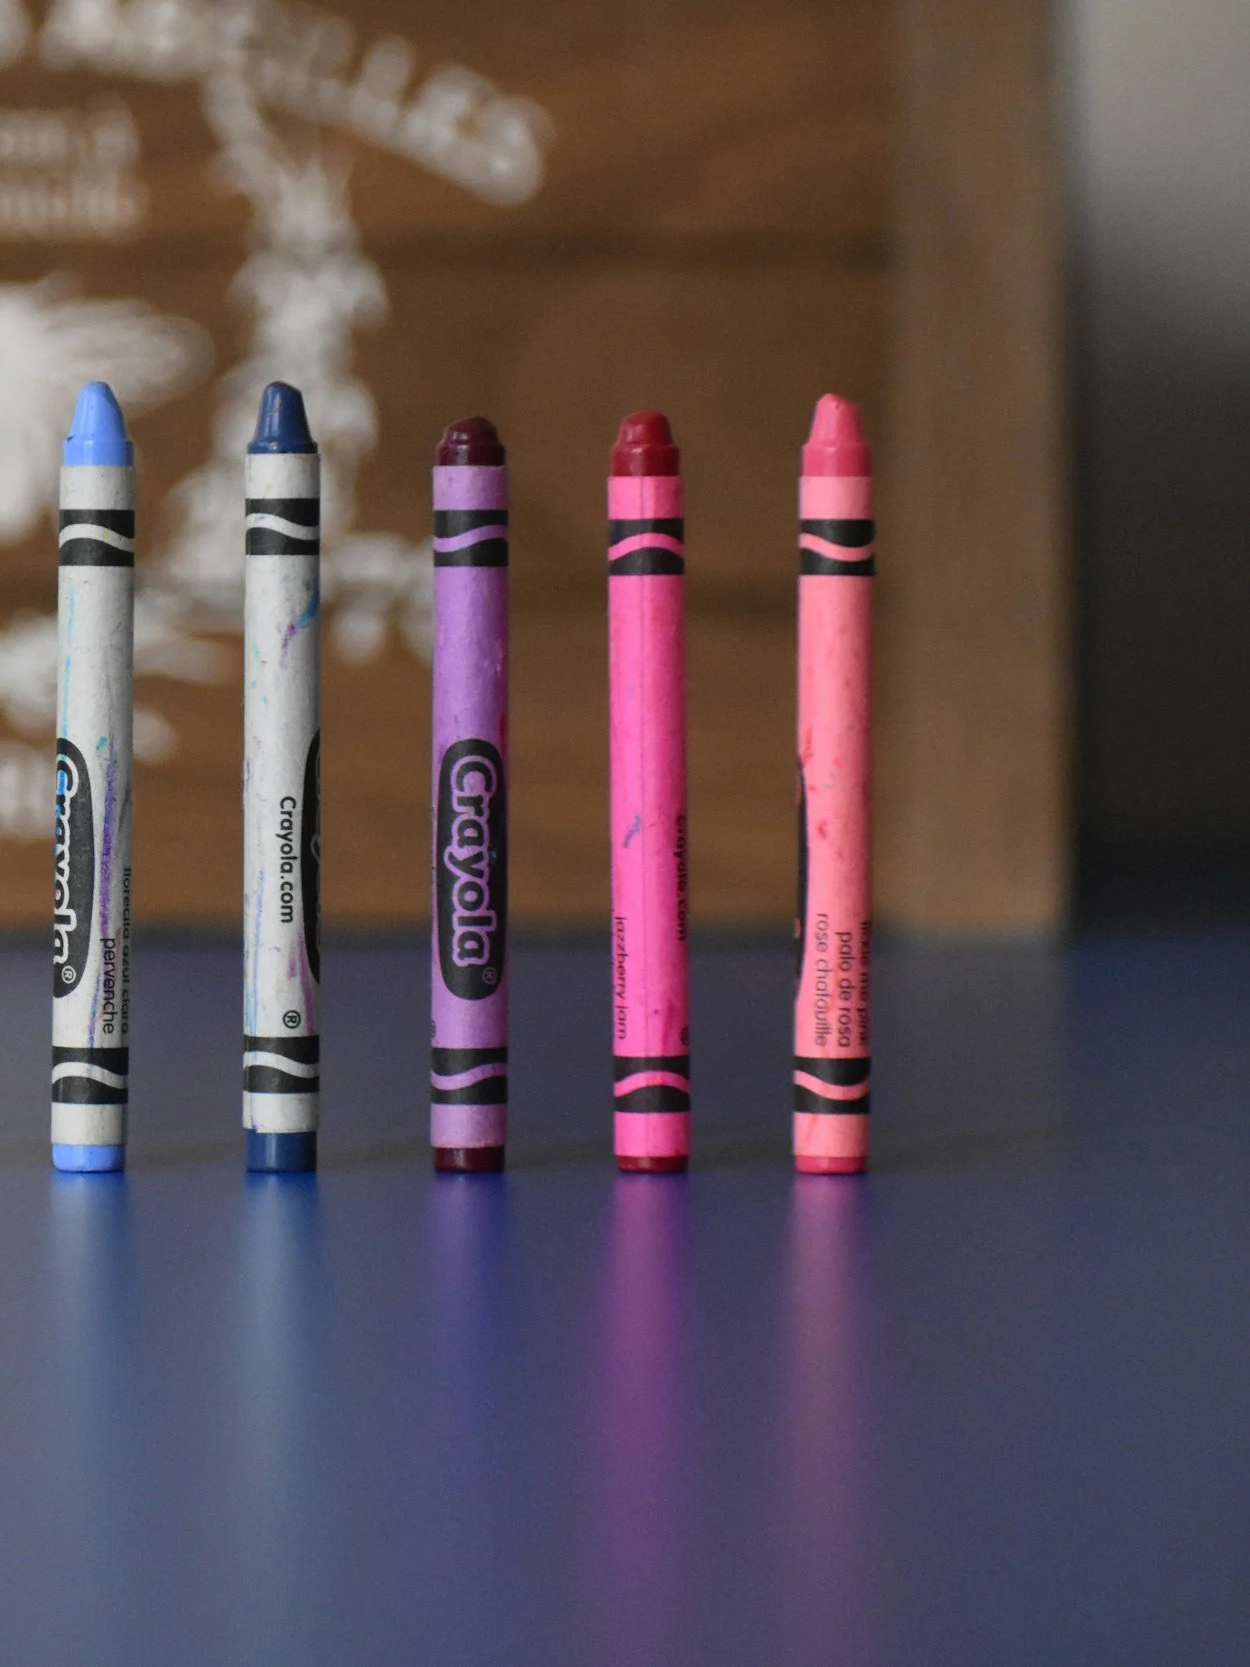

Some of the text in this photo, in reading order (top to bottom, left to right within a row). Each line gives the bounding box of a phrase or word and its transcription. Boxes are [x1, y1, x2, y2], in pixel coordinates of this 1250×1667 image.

[275, 796, 298, 923] Crayola.com
[443, 755, 497, 967] Crayola
[100, 938, 119, 1034] pervenche
[614, 916, 630, 1040] jazzberry jam
[815, 913, 835, 1046] rose chatouille
[835, 932, 856, 1048] palo de rosa
